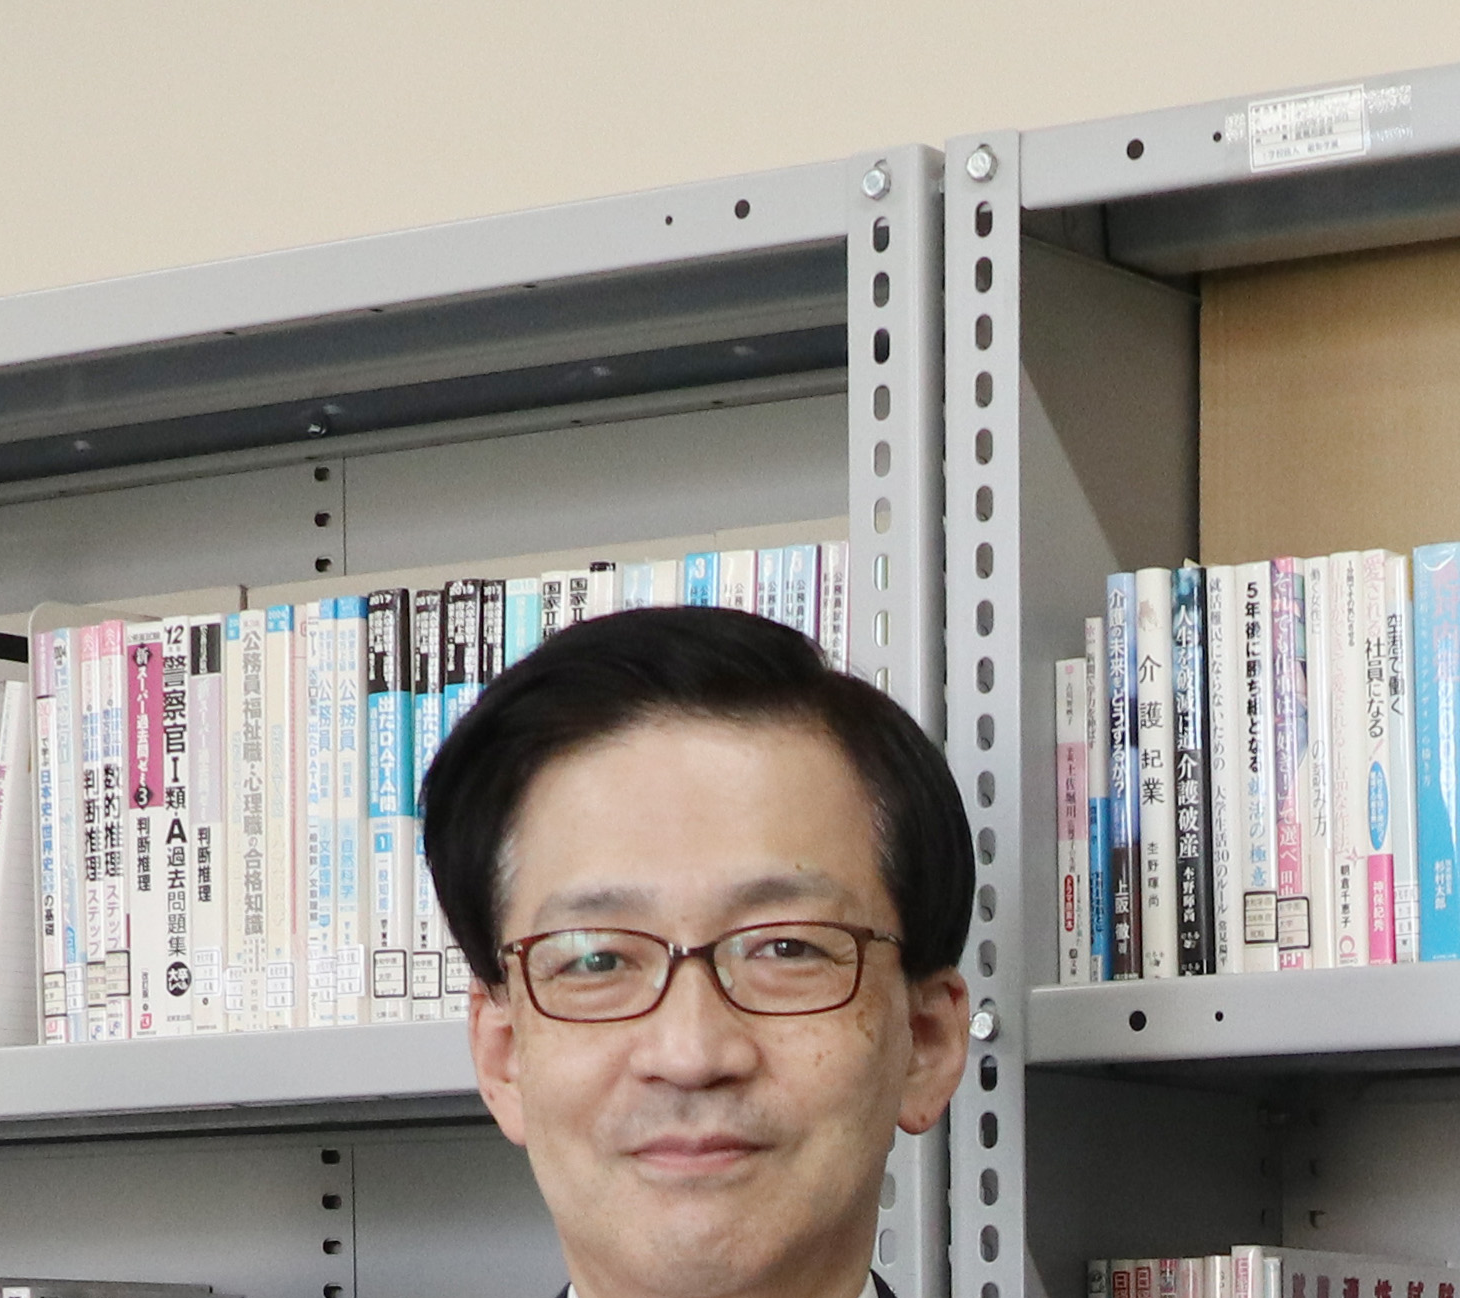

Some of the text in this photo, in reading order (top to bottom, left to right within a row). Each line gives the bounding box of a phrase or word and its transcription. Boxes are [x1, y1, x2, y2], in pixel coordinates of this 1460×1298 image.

[1245, 582, 1261, 774] 5年後に勝ち組となる
[137, 816, 151, 892] 判断推理
[198, 826, 212, 902] 判断推理
[1214, 784, 1230, 917] 大学生活30のルール
